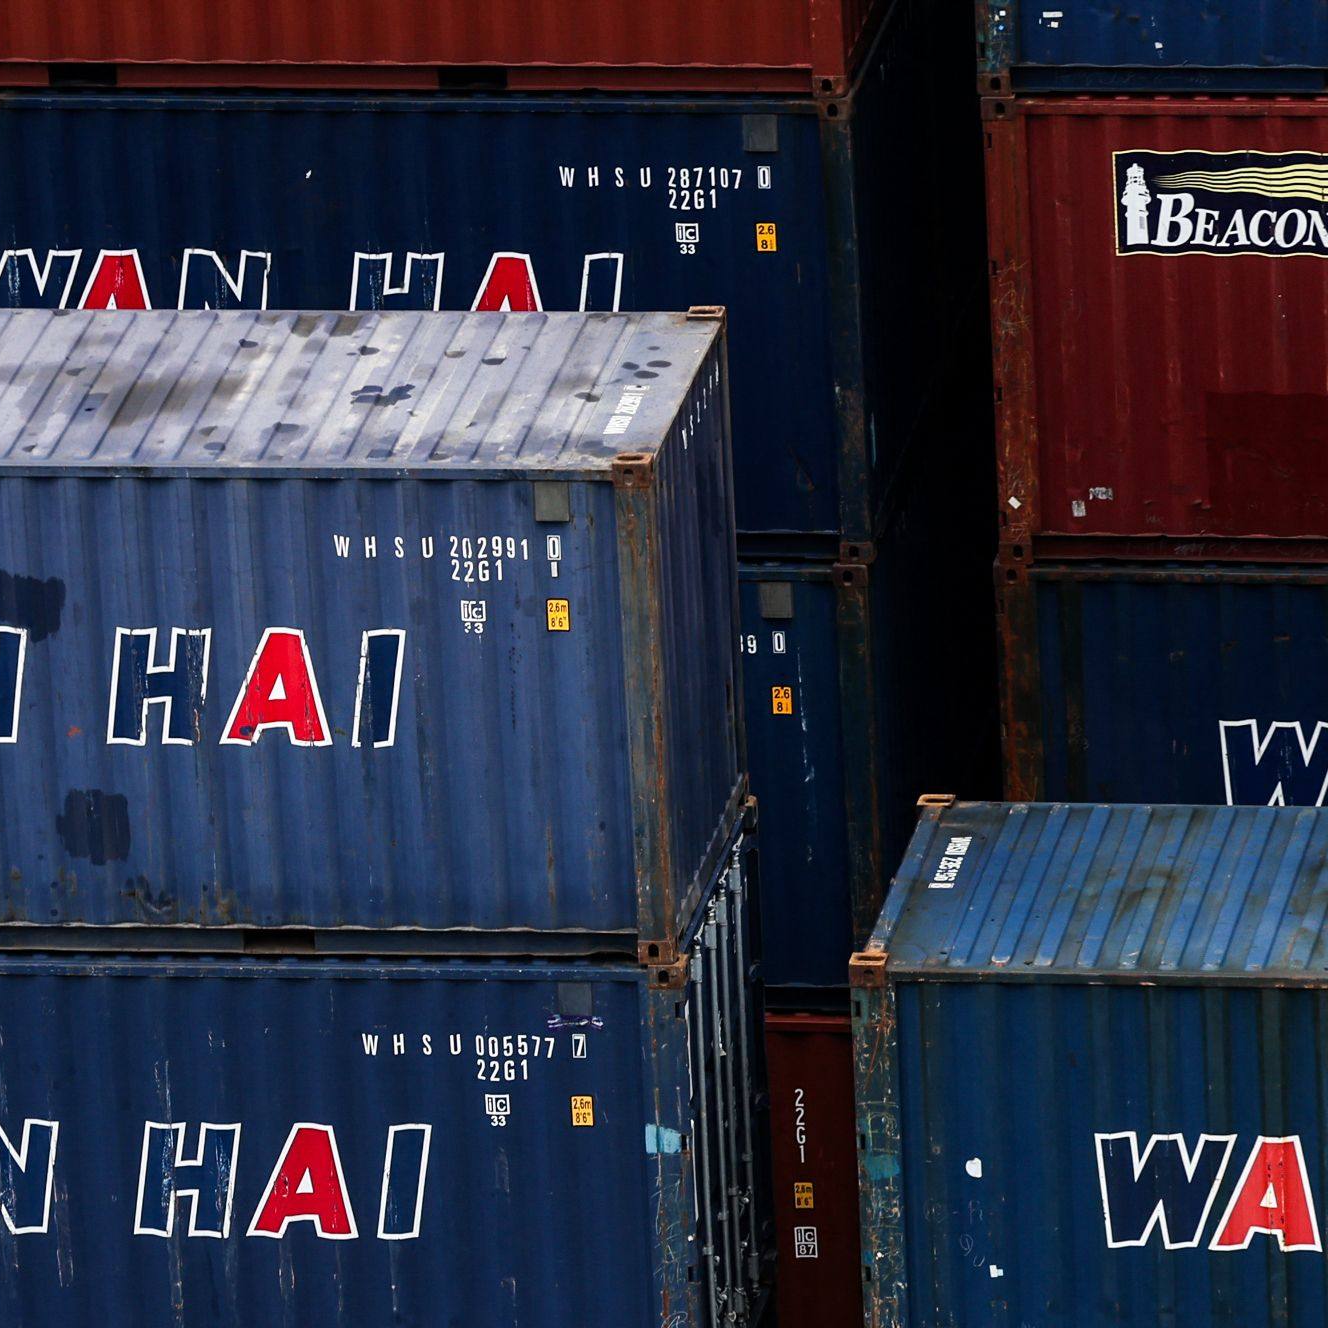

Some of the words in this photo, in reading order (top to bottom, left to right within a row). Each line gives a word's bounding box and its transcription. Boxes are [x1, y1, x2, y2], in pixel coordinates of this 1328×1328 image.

[668, 167, 742, 189] 287107
[669, 189, 717, 210] 22G1
[758, 225, 774, 235] 2.6
[680, 244, 695, 254] 33
[450, 536, 528, 560] 202991
[451, 559, 503, 582] 22G1
[548, 603, 568, 613] 2.6m
[464, 622, 483, 634] 33
[106, 626, 405, 748] HAI
[774, 688, 790, 699] 2.6
[475, 1034, 555, 1058] 005577
[477, 1059, 528, 1082] 22G1
[490, 1116, 506, 1127] 33
[794, 1088, 806, 1163] 22G1
[133, 1120, 432, 1240] HAI
[799, 1244, 814, 1255] 87
